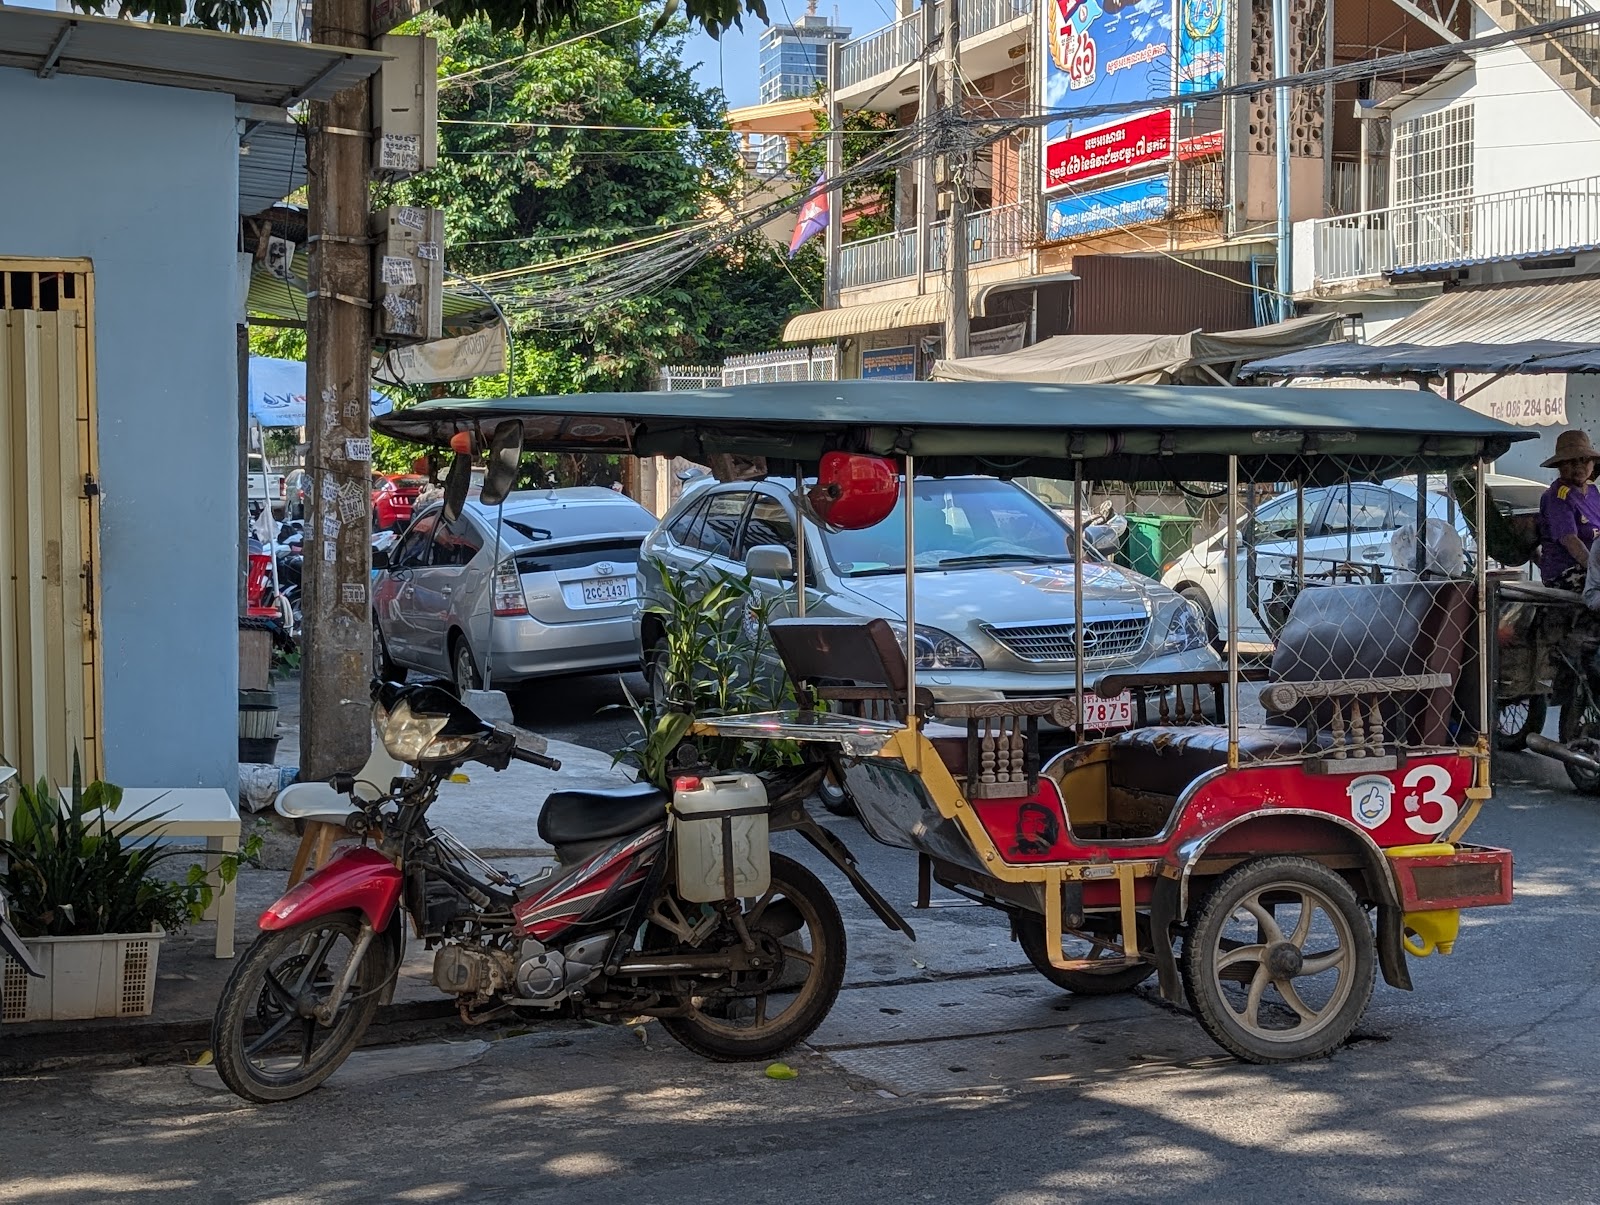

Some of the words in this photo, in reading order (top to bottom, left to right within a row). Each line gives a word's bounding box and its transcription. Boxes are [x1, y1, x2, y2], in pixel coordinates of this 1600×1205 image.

[1506, 400, 1520, 418] 086
[1523, 399, 1541, 416] 284
[1544, 397, 1562, 415] 648
[585, 584, 627, 600] 2CC-1437
[1402, 764, 1459, 835] 3
